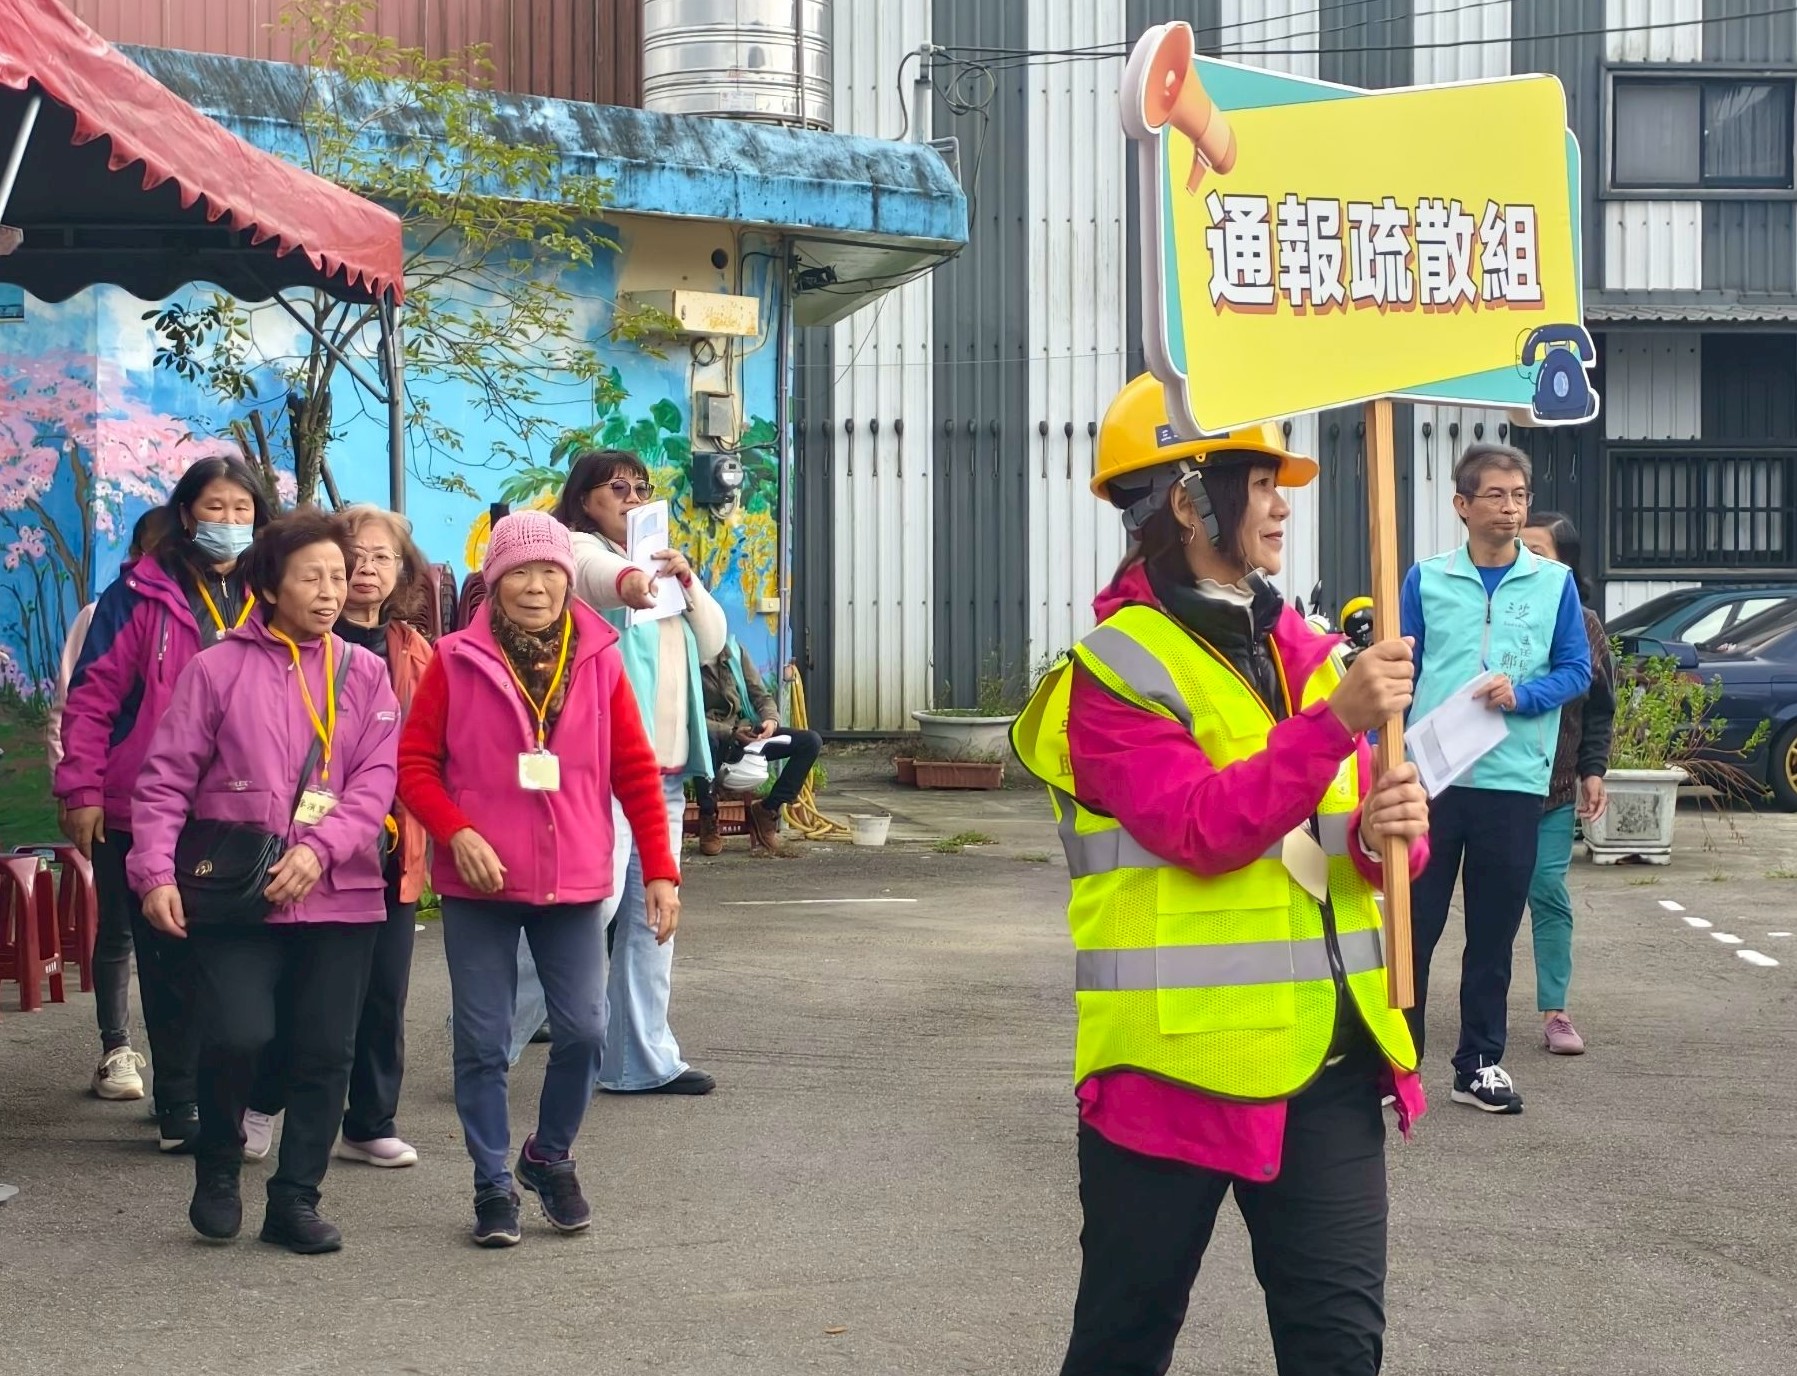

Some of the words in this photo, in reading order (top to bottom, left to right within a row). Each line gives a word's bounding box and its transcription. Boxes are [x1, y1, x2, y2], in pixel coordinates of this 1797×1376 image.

[1204, 188, 1545, 316] 通報疏散組
